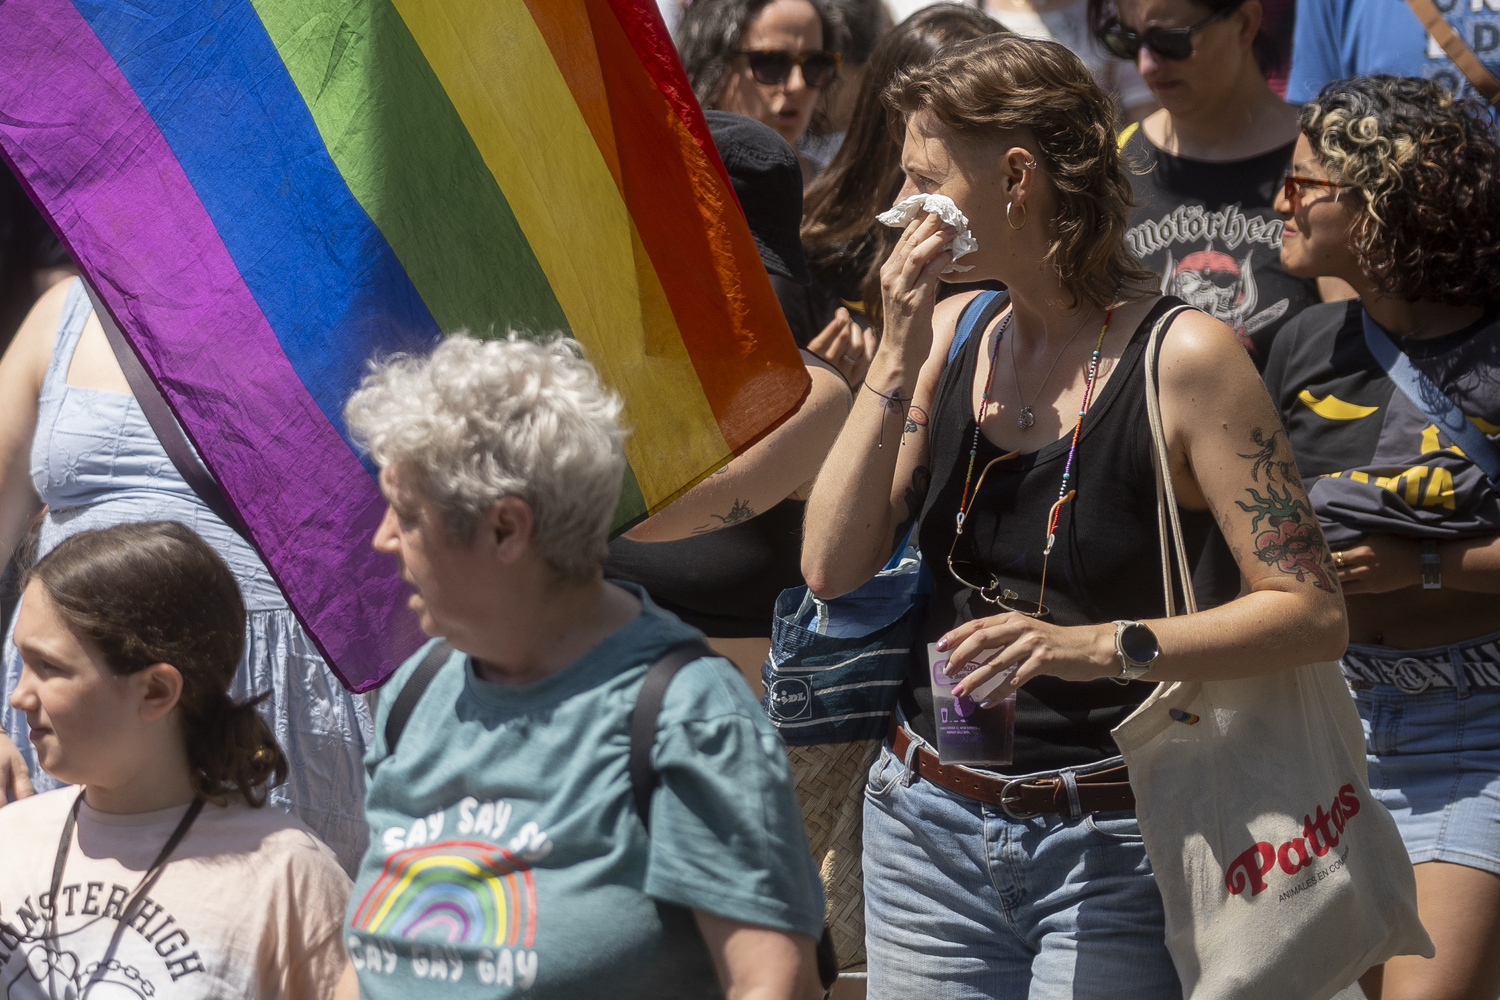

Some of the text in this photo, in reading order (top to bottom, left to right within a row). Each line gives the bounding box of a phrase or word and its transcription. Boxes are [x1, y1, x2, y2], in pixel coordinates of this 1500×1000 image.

[382, 810, 446, 852] SAY
[457, 796, 513, 840] SAY
[1225, 783, 1361, 896] Pattas
[1278, 876, 1318, 903] ANIMALES
[1317, 869, 1329, 881] EN
[127, 896, 205, 982] HIGH
[477, 948, 539, 989] GAY
